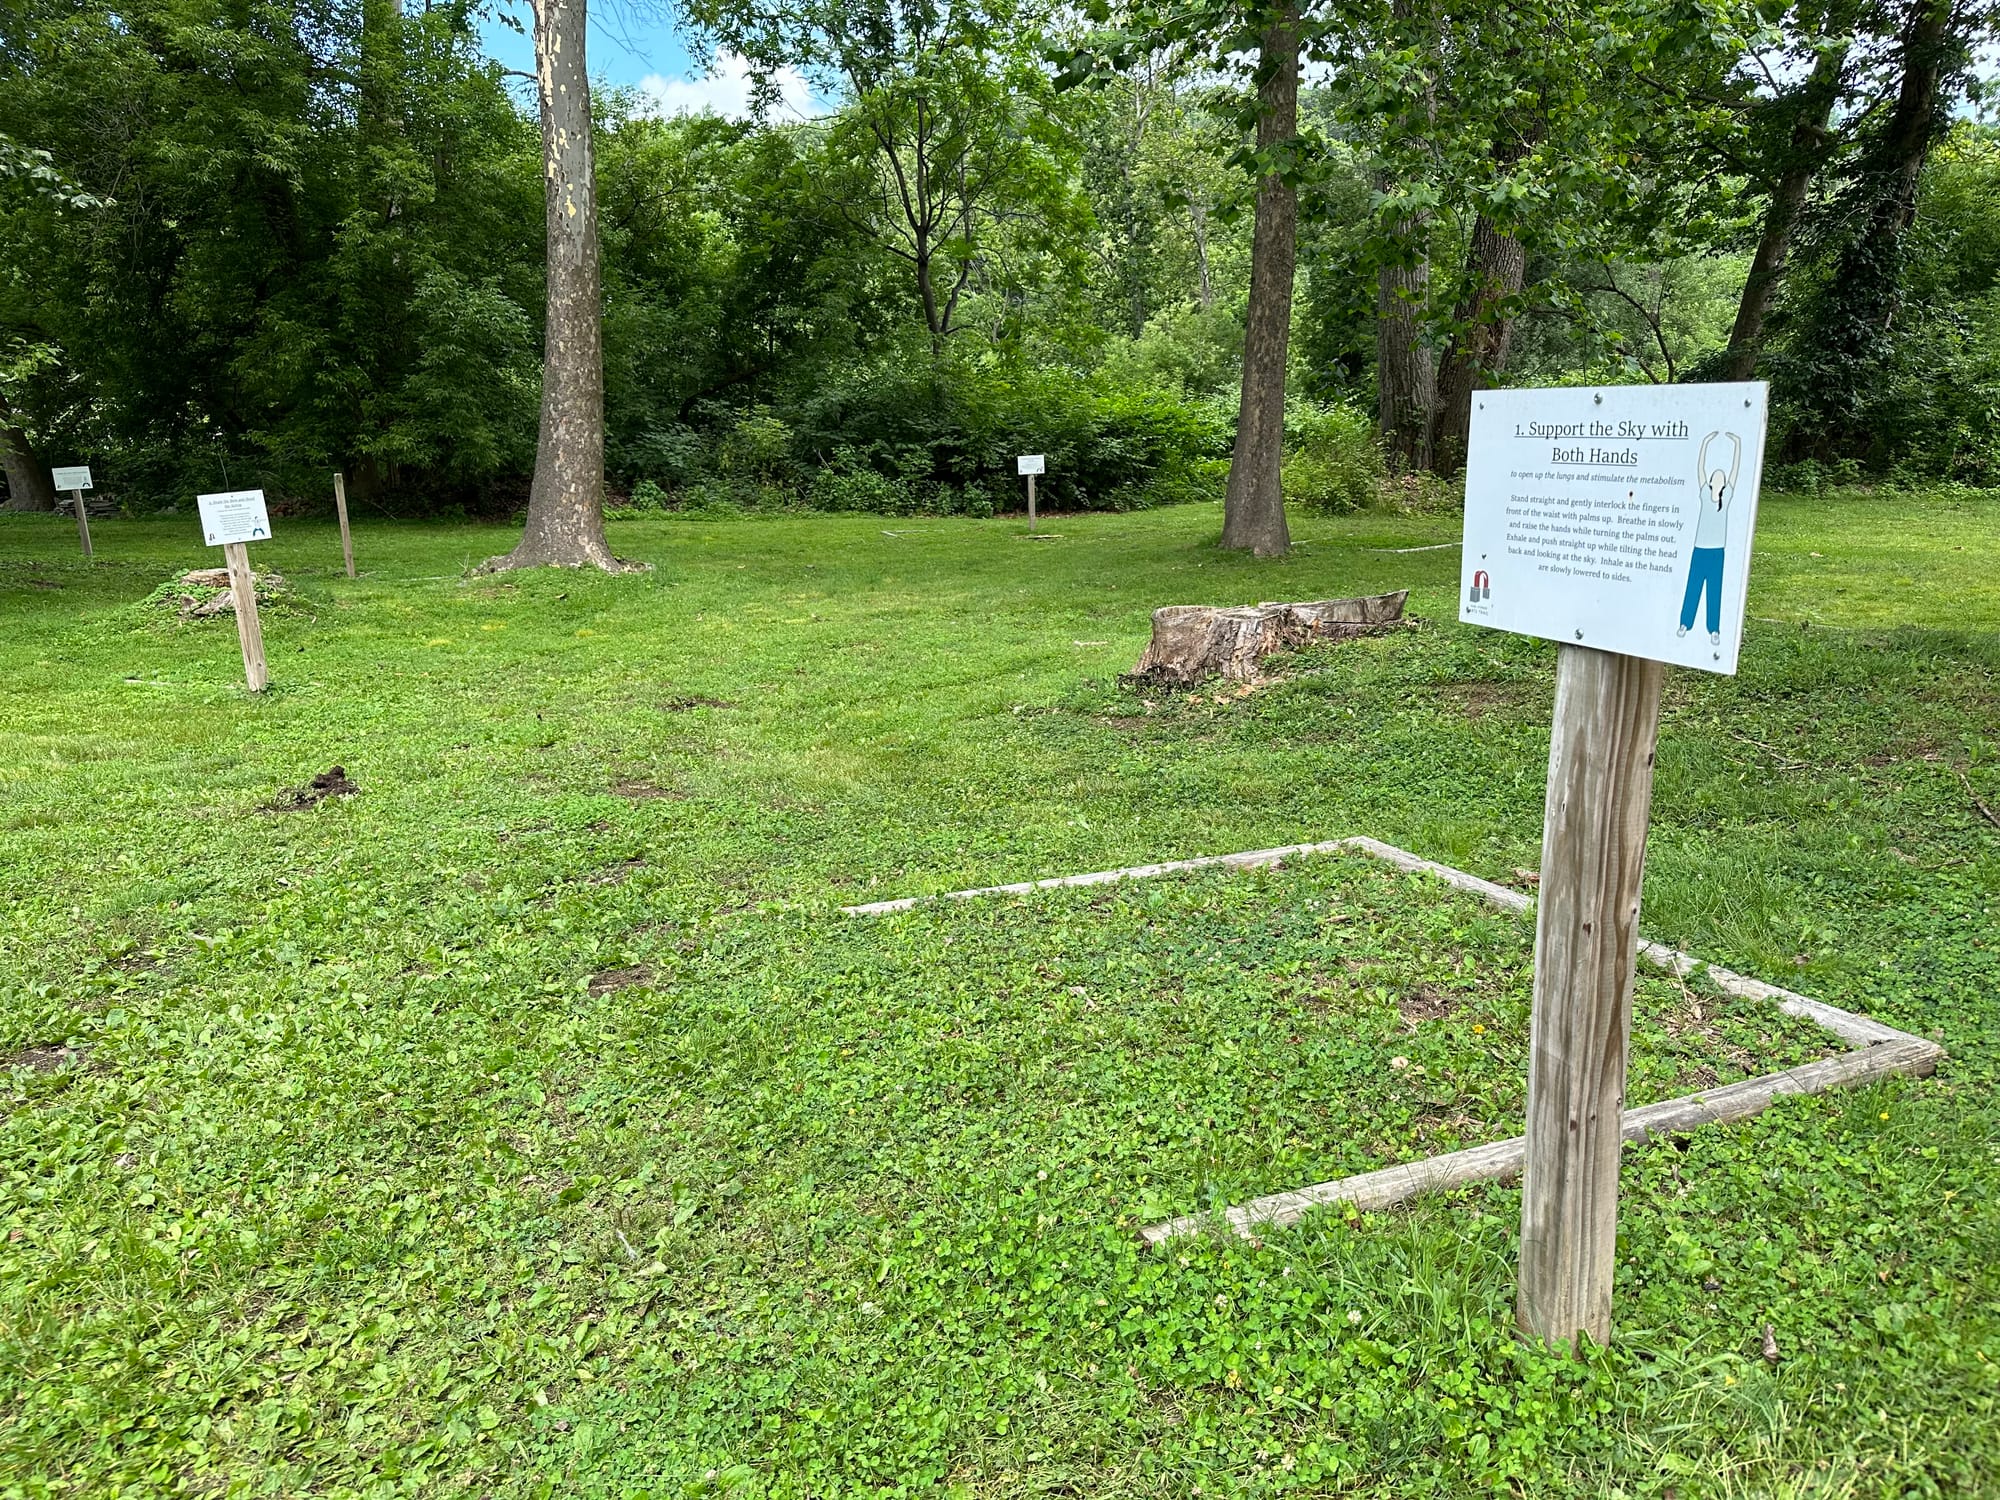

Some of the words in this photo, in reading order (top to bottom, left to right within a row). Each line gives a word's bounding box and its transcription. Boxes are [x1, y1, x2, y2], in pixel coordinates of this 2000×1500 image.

[1515, 424, 1524, 435] 1.
[1529, 422, 1584, 440] Support
[1590, 421, 1612, 436] the
[1618, 421, 1646, 440] Sky
[1652, 421, 1688, 437] with
[1552, 448, 1584, 462] Both
[1590, 448, 1638, 464] Hands
[1556, 472, 1574, 481] lungs
[1591, 473, 1624, 483] stimulate
[1626, 475, 1638, 483] the
[1640, 476, 1685, 486] metabolism
[1530, 496, 1555, 506] straight
[1571, 499, 1592, 509] gently
[1594, 500, 1626, 509] interlock
[1628, 502, 1640, 510] the
[1642, 503, 1670, 514] fingers
[1672, 505, 1679, 513] in
[1506, 507, 1521, 515] front
[1579, 513, 1600, 522] palms
[1618, 516, 1647, 525] Breathe
[1658, 519, 1684, 531] slowly
[1551, 524, 1570, 533] hands
[1573, 527, 1591, 535] while
[1593, 529, 1620, 539] turning
[1636, 533, 1659, 542] palms
[1507, 533, 1527, 542] Exhale
[1542, 538, 1557, 546] push
[1559, 539, 1585, 549] straight
[1598, 543, 1618, 552] while
[1620, 545, 1642, 556] tilting
[1644, 547, 1656, 556] the
[1658, 549, 1677, 558] head
[1508, 546, 1522, 554] back
[1537, 550, 1560, 560] looking
[1583, 556, 1597, 565] sky.
[1601, 557, 1624, 567] Inhale
[1635, 561, 1647, 570] the
[1649, 562, 1672, 572] hands
[1550, 565, 1571, 576] slowly
[1573, 567, 1600, 578] lowered
[1612, 573, 1632, 582] sides.
